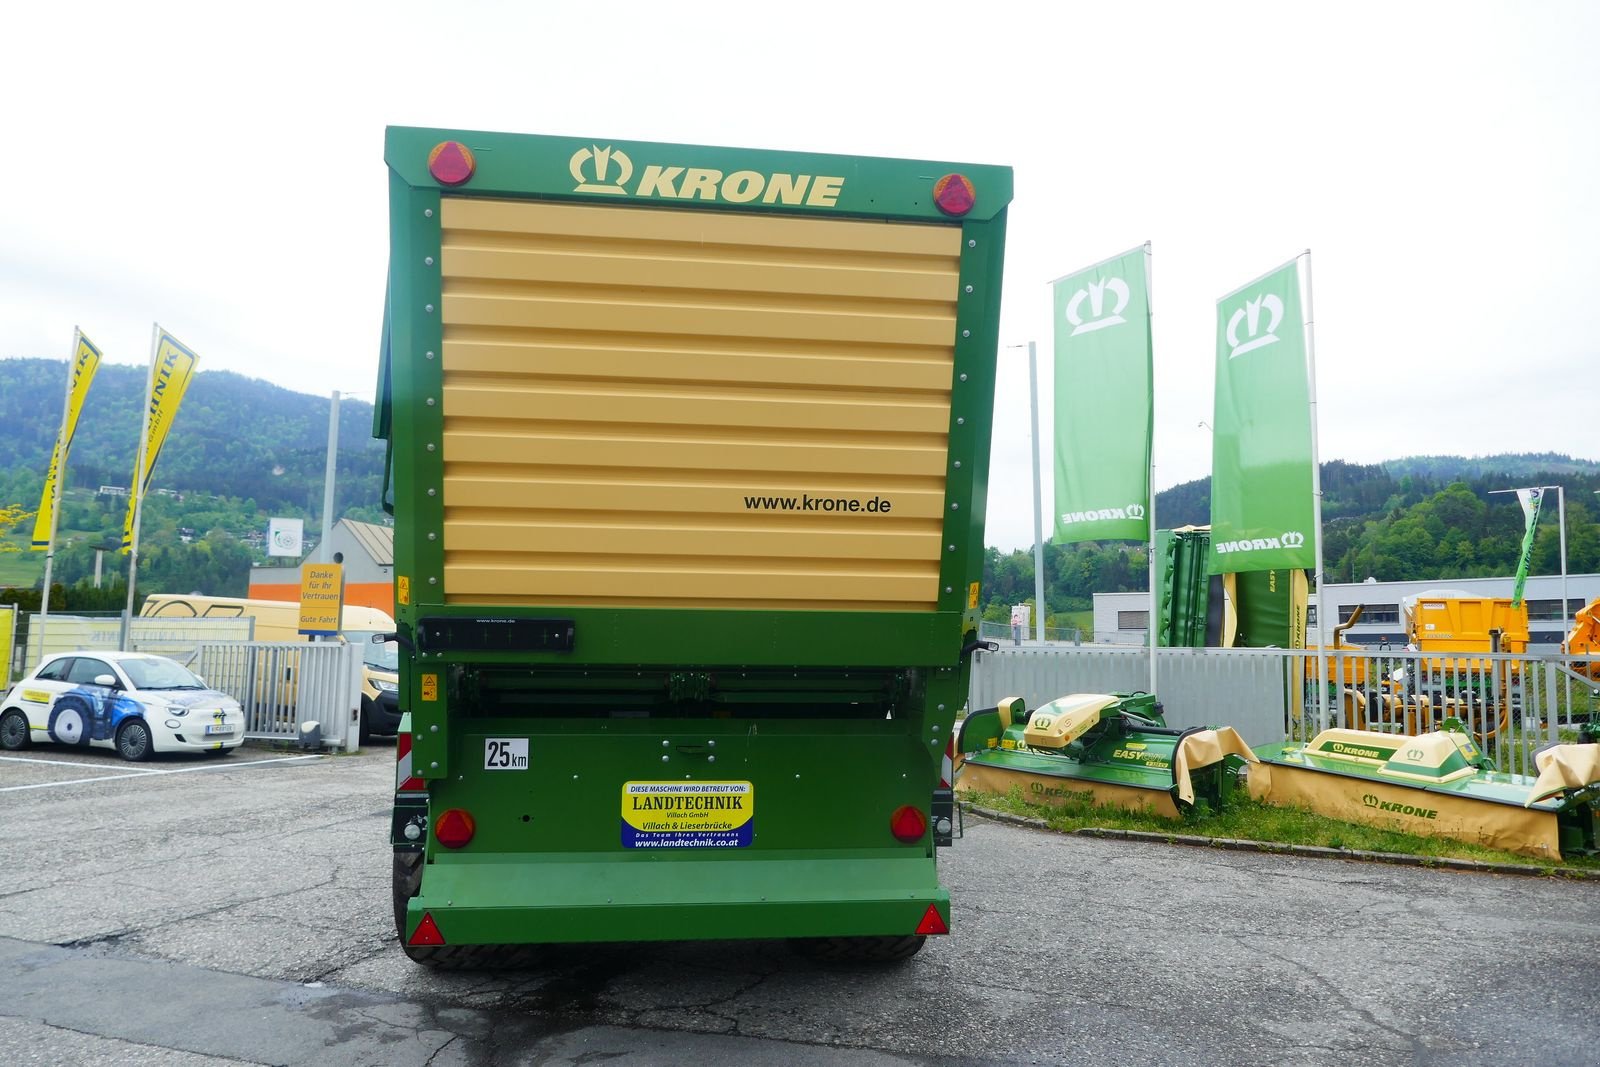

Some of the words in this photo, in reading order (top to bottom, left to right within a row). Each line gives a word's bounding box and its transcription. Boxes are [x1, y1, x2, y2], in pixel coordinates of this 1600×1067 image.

[635, 165, 845, 207] KRONE
[744, 494, 891, 513] www.krone.de
[310, 571, 333, 579] Danke
[308, 581, 320, 590] für
[321, 581, 332, 589] Ihr
[302, 592, 338, 601] Vertrauen
[300, 615, 317, 623] Gute
[318, 615, 337, 624] Fahrt
[487, 741, 510, 767] 25
[511, 753, 527, 767] km
[1343, 747, 1380, 758] KRONE
[632, 796, 743, 811] LANDTECHNIK
[1379, 801, 1439, 820] KRONE
[642, 822, 671, 830] Villach
[671, 822, 679, 830] &
[680, 821, 733, 830] Lieserbrücke
[635, 838, 739, 848] www.landtechnik.co.at
